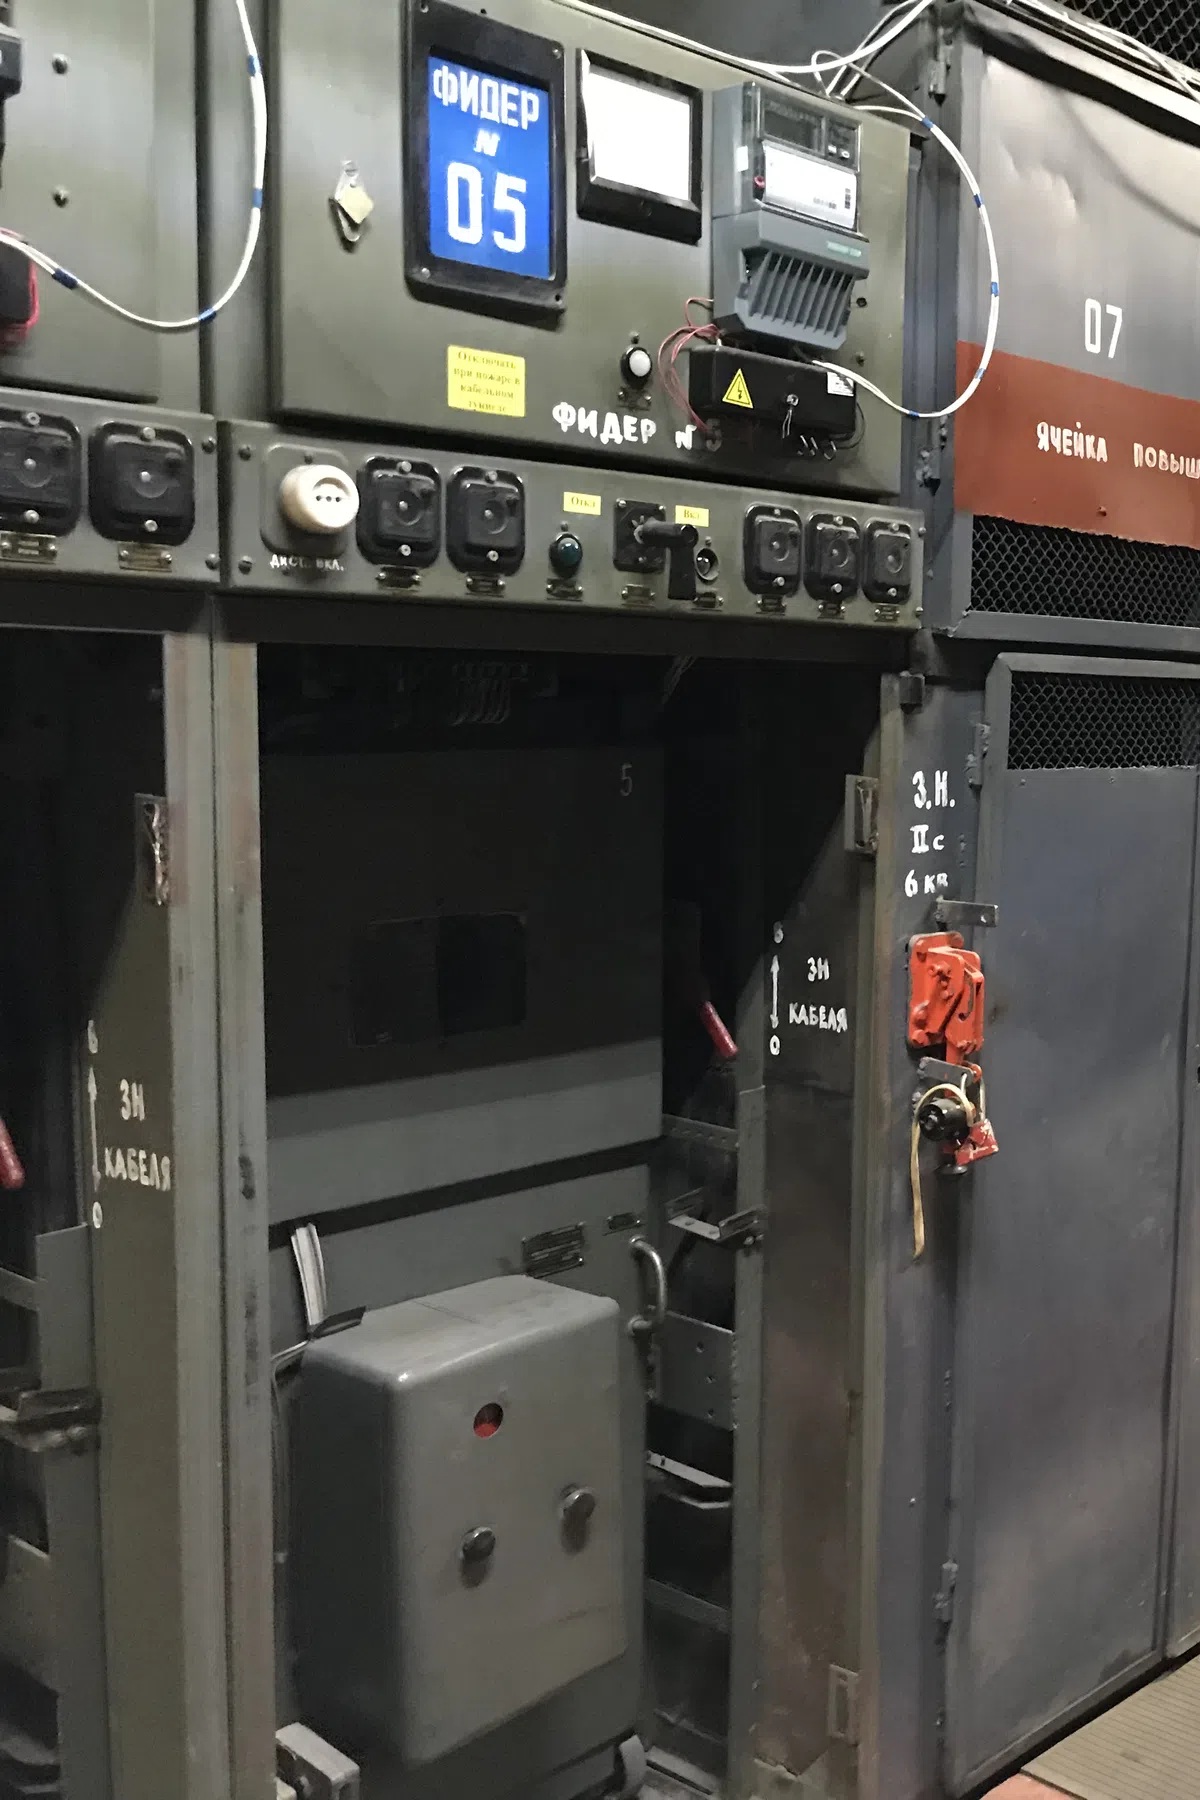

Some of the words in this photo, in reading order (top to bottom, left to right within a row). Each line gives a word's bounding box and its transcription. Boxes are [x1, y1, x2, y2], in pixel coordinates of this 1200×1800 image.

[433, 65, 540, 130] ФИДЕР
[447, 162, 527, 254] 05
[1085, 298, 1123, 359] 07
[552, 401, 657, 445] ФИДЕР
[1036, 421, 1108, 463] ЯЧЕЙКА
[620, 763, 633, 797] 5
[807, 957, 830, 982] ЗН
[789, 1002, 848, 1033] КАБЕЛЯ
[119, 1079, 146, 1122] ЗН
[104, 1147, 171, 1192] КАБЕЛЯ
